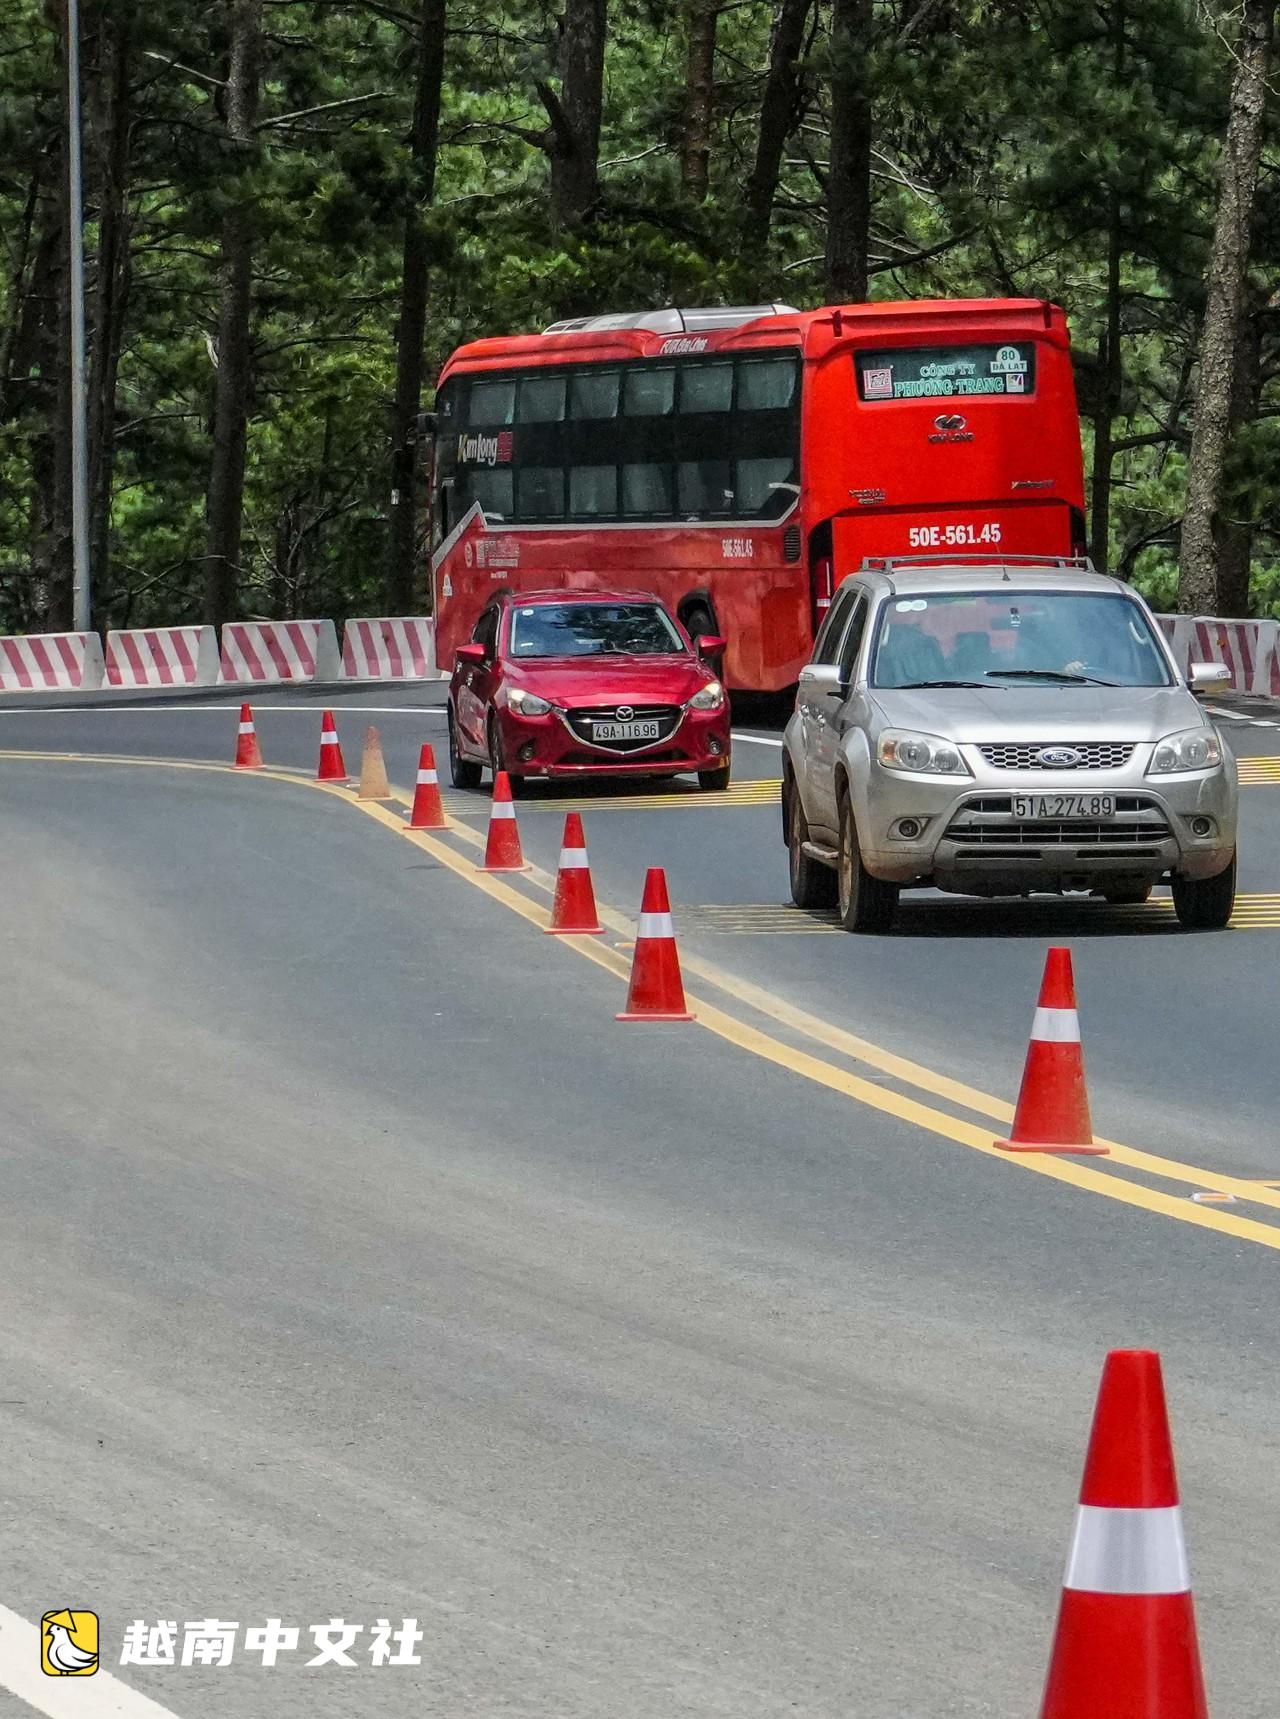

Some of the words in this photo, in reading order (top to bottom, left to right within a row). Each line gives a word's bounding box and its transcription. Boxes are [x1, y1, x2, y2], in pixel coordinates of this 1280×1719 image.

[1001, 350, 1015, 361] 80
[920, 363, 956, 377] CÔNG
[958, 363, 976, 375] TY
[909, 524, 1001, 547] 50E-561.45
[596, 724, 657, 739] 49A-116.96
[1015, 797, 1112, 817] 51A-274.89
